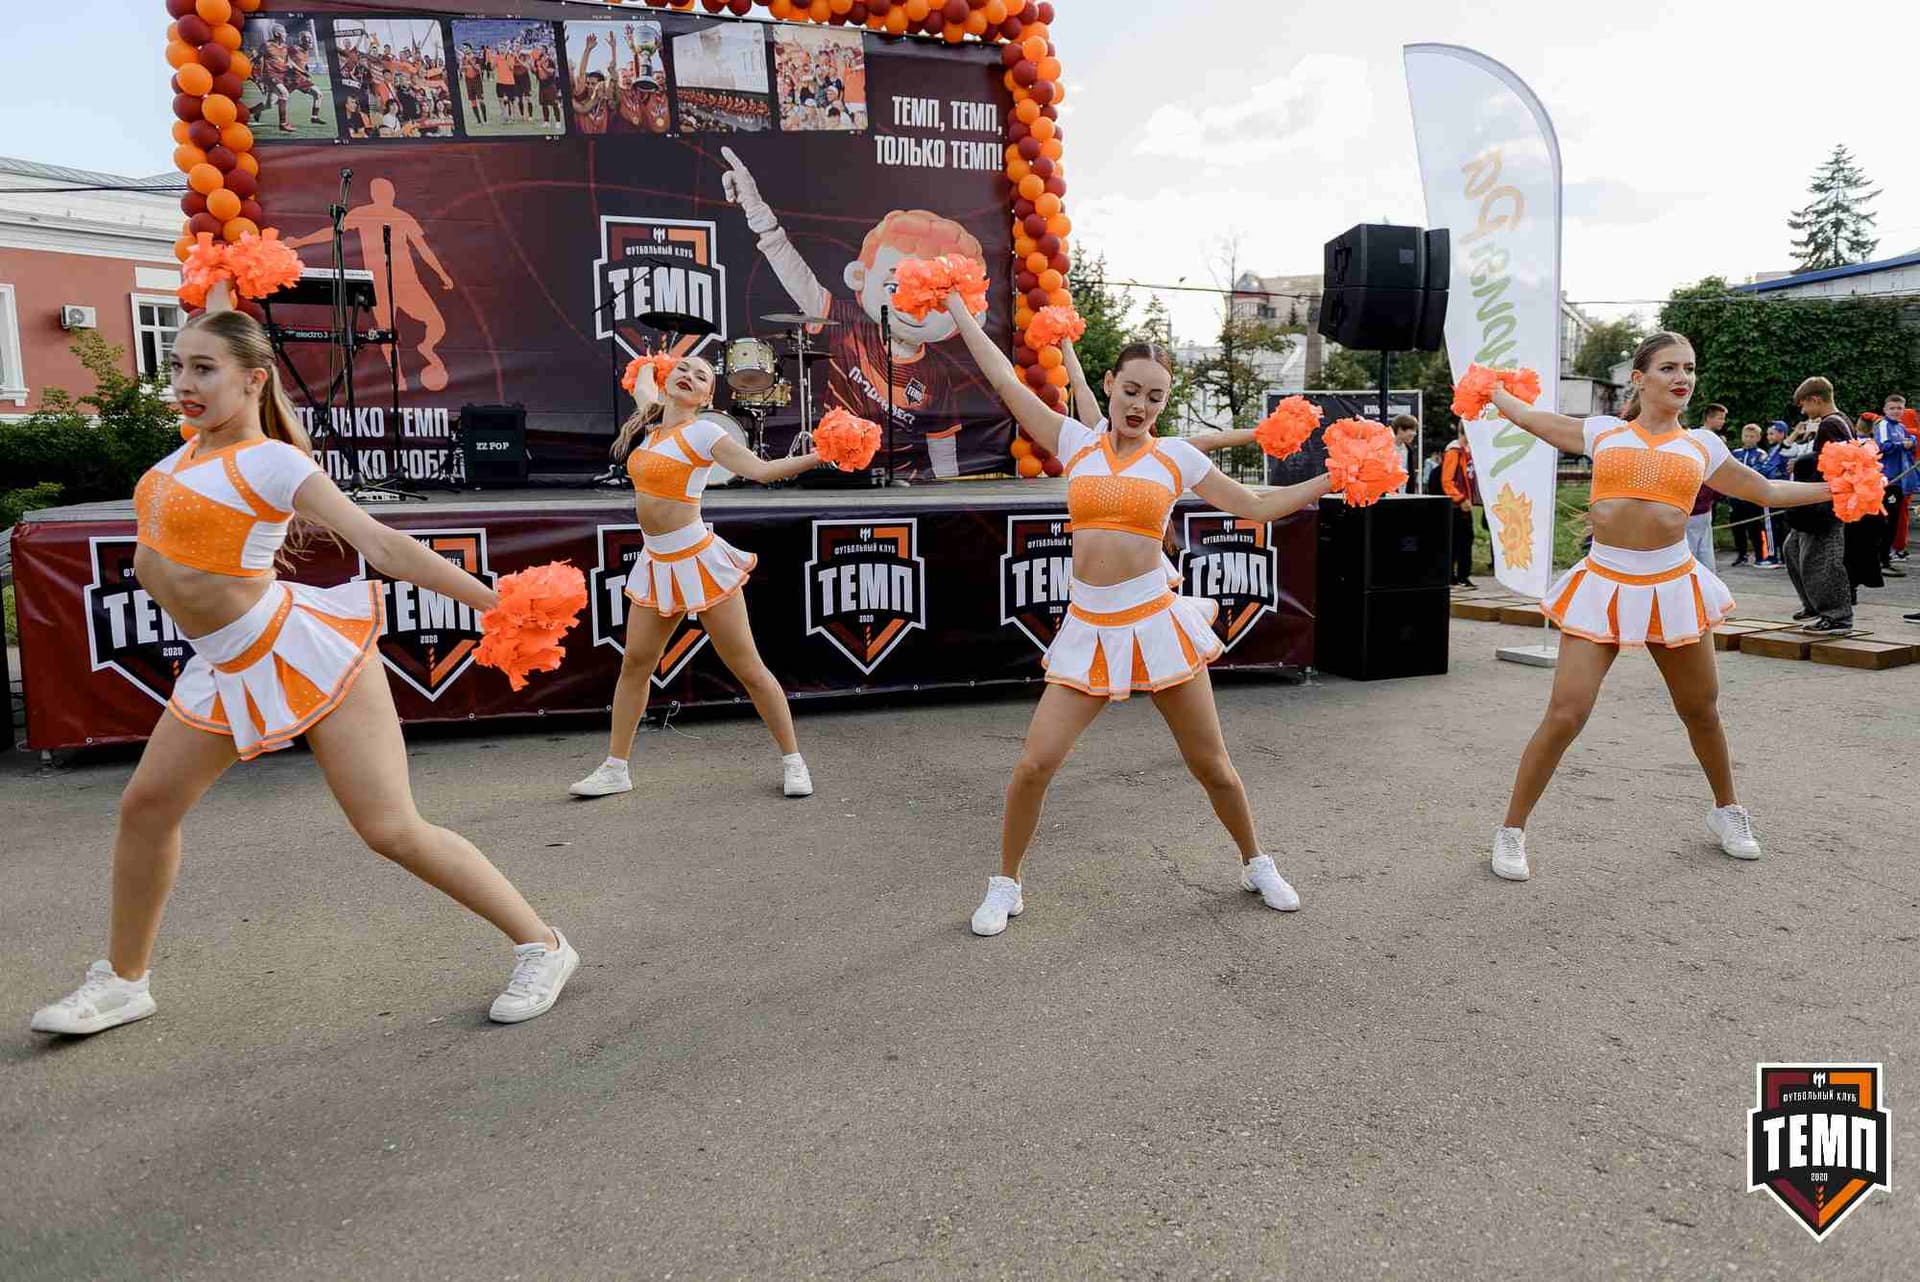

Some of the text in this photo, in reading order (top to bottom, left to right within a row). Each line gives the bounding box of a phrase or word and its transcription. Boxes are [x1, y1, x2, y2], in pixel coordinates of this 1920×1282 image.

[892, 95, 1003, 135] ТЕМП, ТЕМП,
[874, 135, 1003, 170] ТОЛЬКО ТЕМП!
[625, 244, 693, 259] ФУТБОЛЬНЫЙ КЛУБ
[608, 266, 713, 323] ТЕМП
[489, 441, 510, 451] POP
[834, 543, 896, 555] ФУТБОЛЬНЫЙ КЛУБ
[818, 563, 913, 617] ТЕМП
[1189, 551, 1268, 598] ТЕМП
[162, 646, 184, 657] 2020
